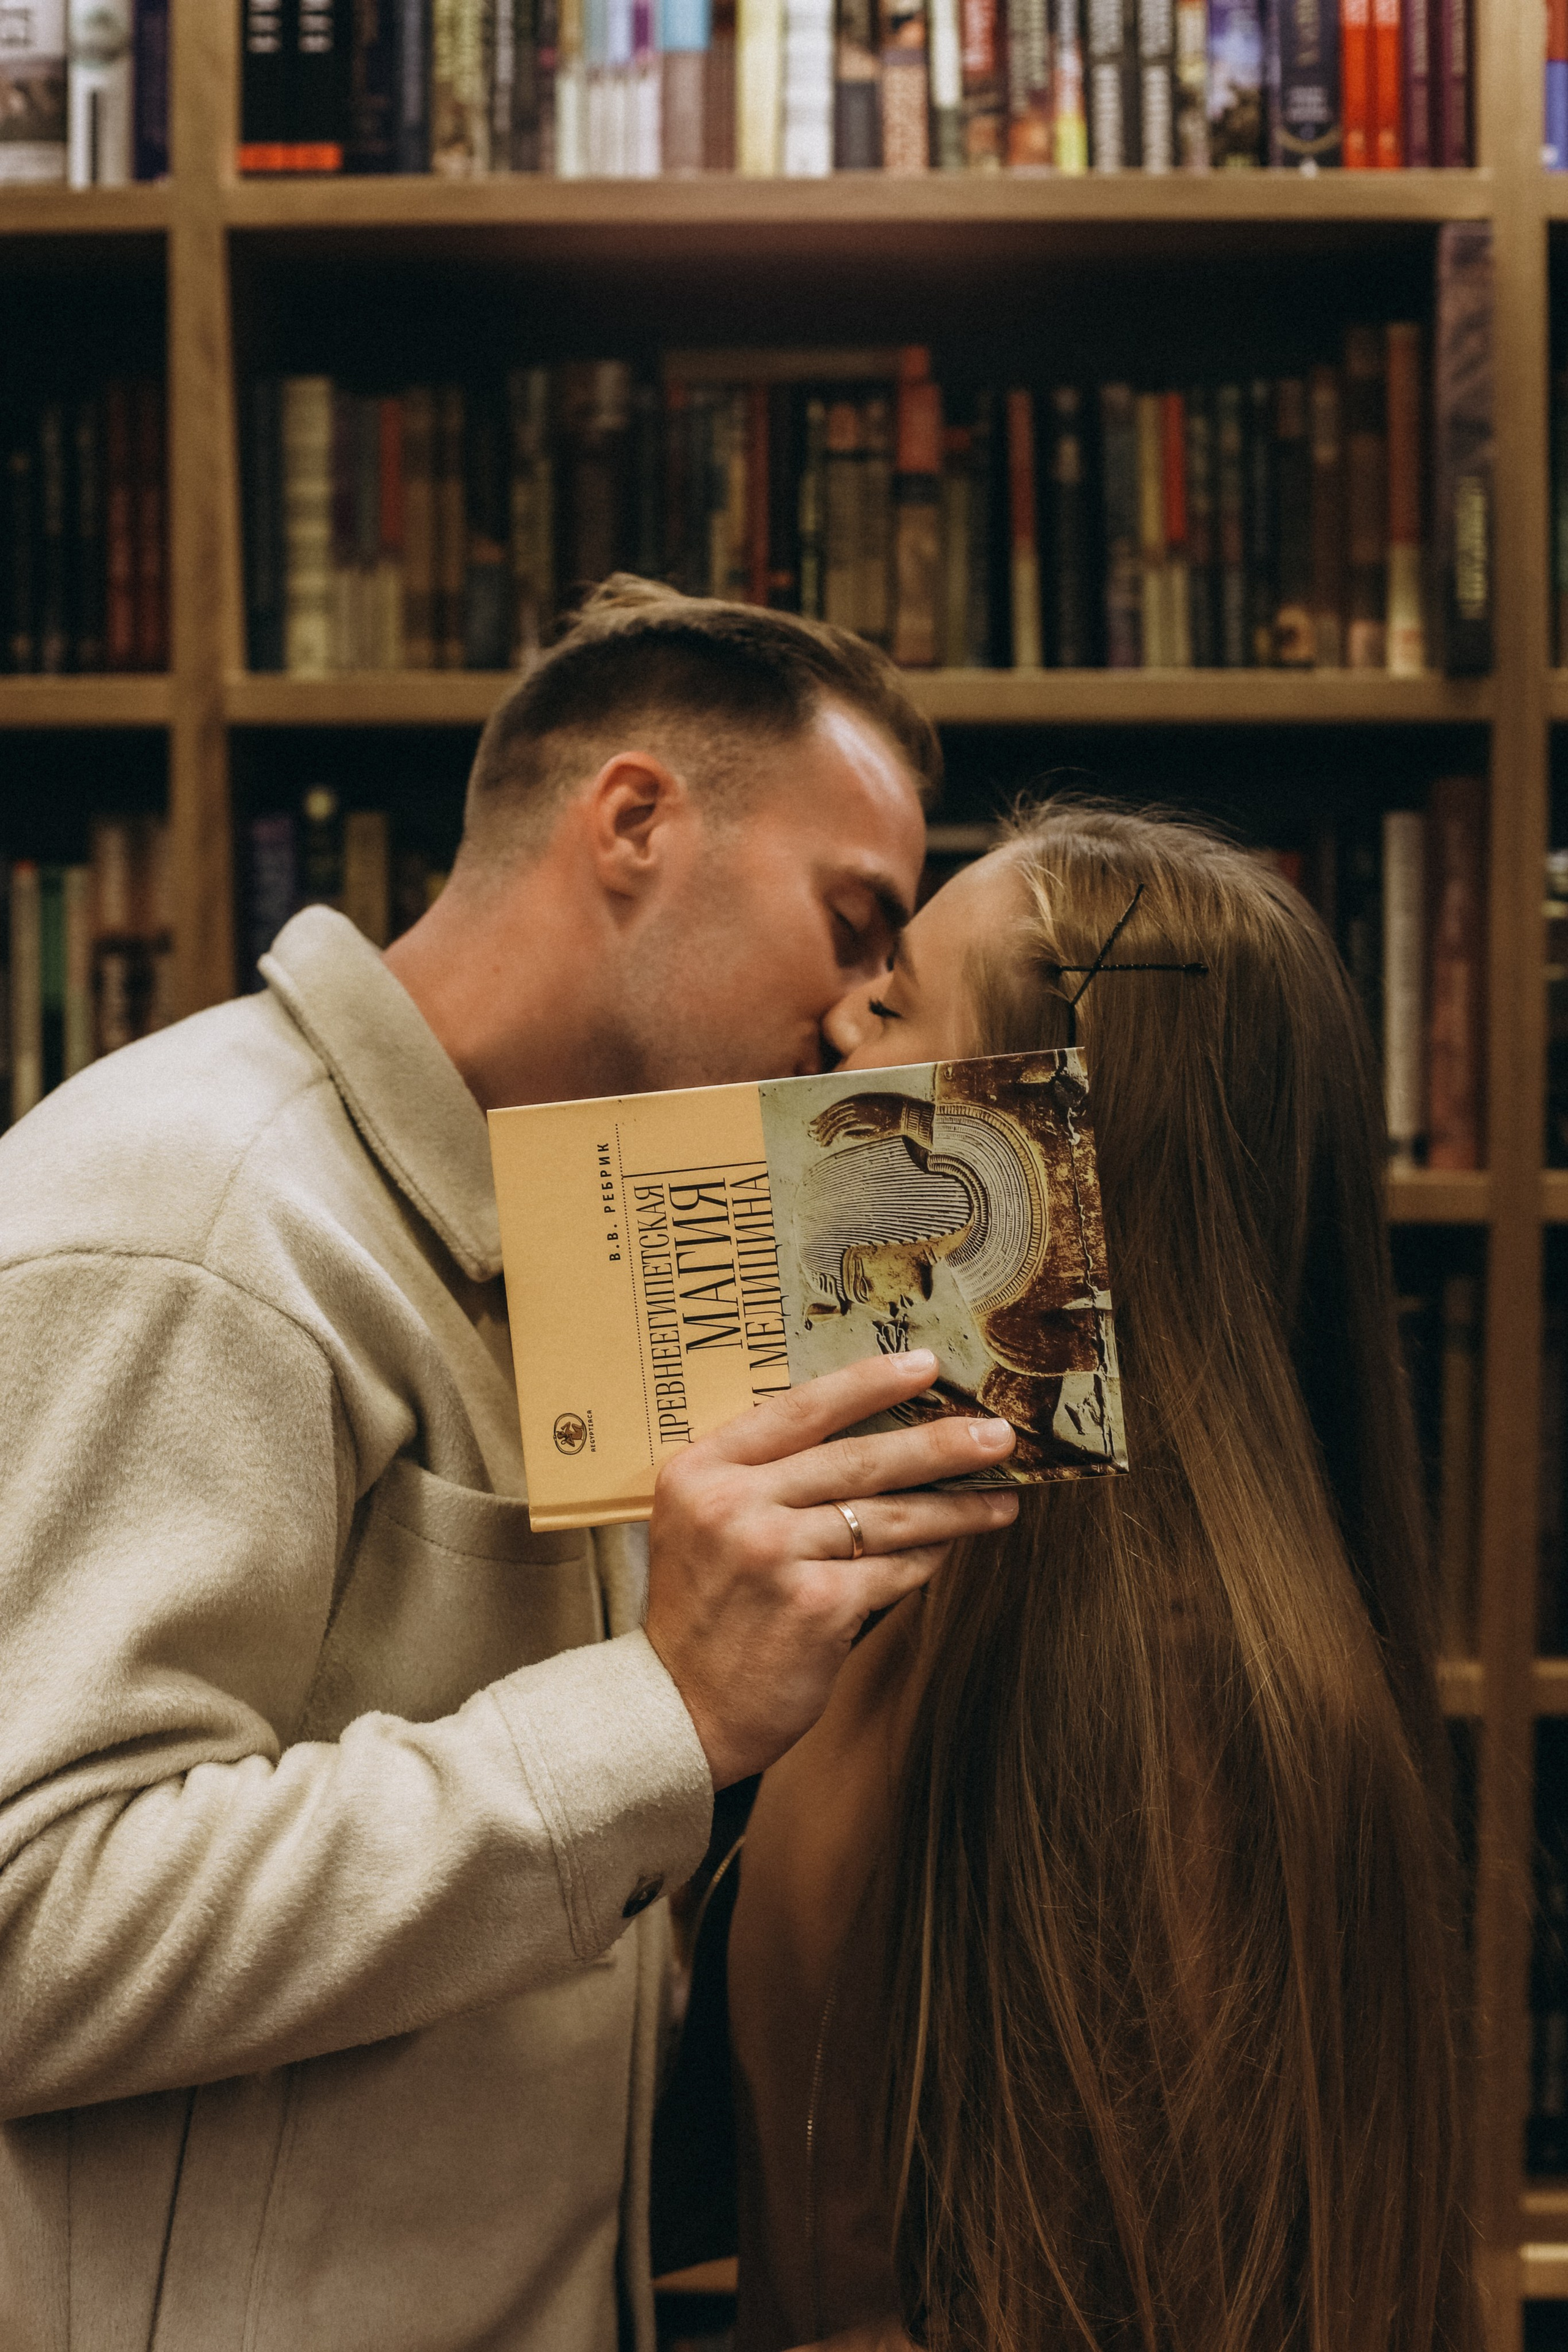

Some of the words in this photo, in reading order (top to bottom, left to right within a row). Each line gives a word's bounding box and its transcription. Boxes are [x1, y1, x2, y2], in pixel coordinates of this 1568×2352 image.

[597, 1143, 616, 1213] РЕБРИК
[607, 1224, 621, 1261] В.В.
[669, 1177, 743, 1354] МАГИЯ
[729, 1170, 791, 1371] МЕДИЦИНА
[633, 1183, 695, 1444] ДРЕВНЕЕГИПЕТСКАЯ
[587, 1410, 596, 1452] AEGYPTIACA
